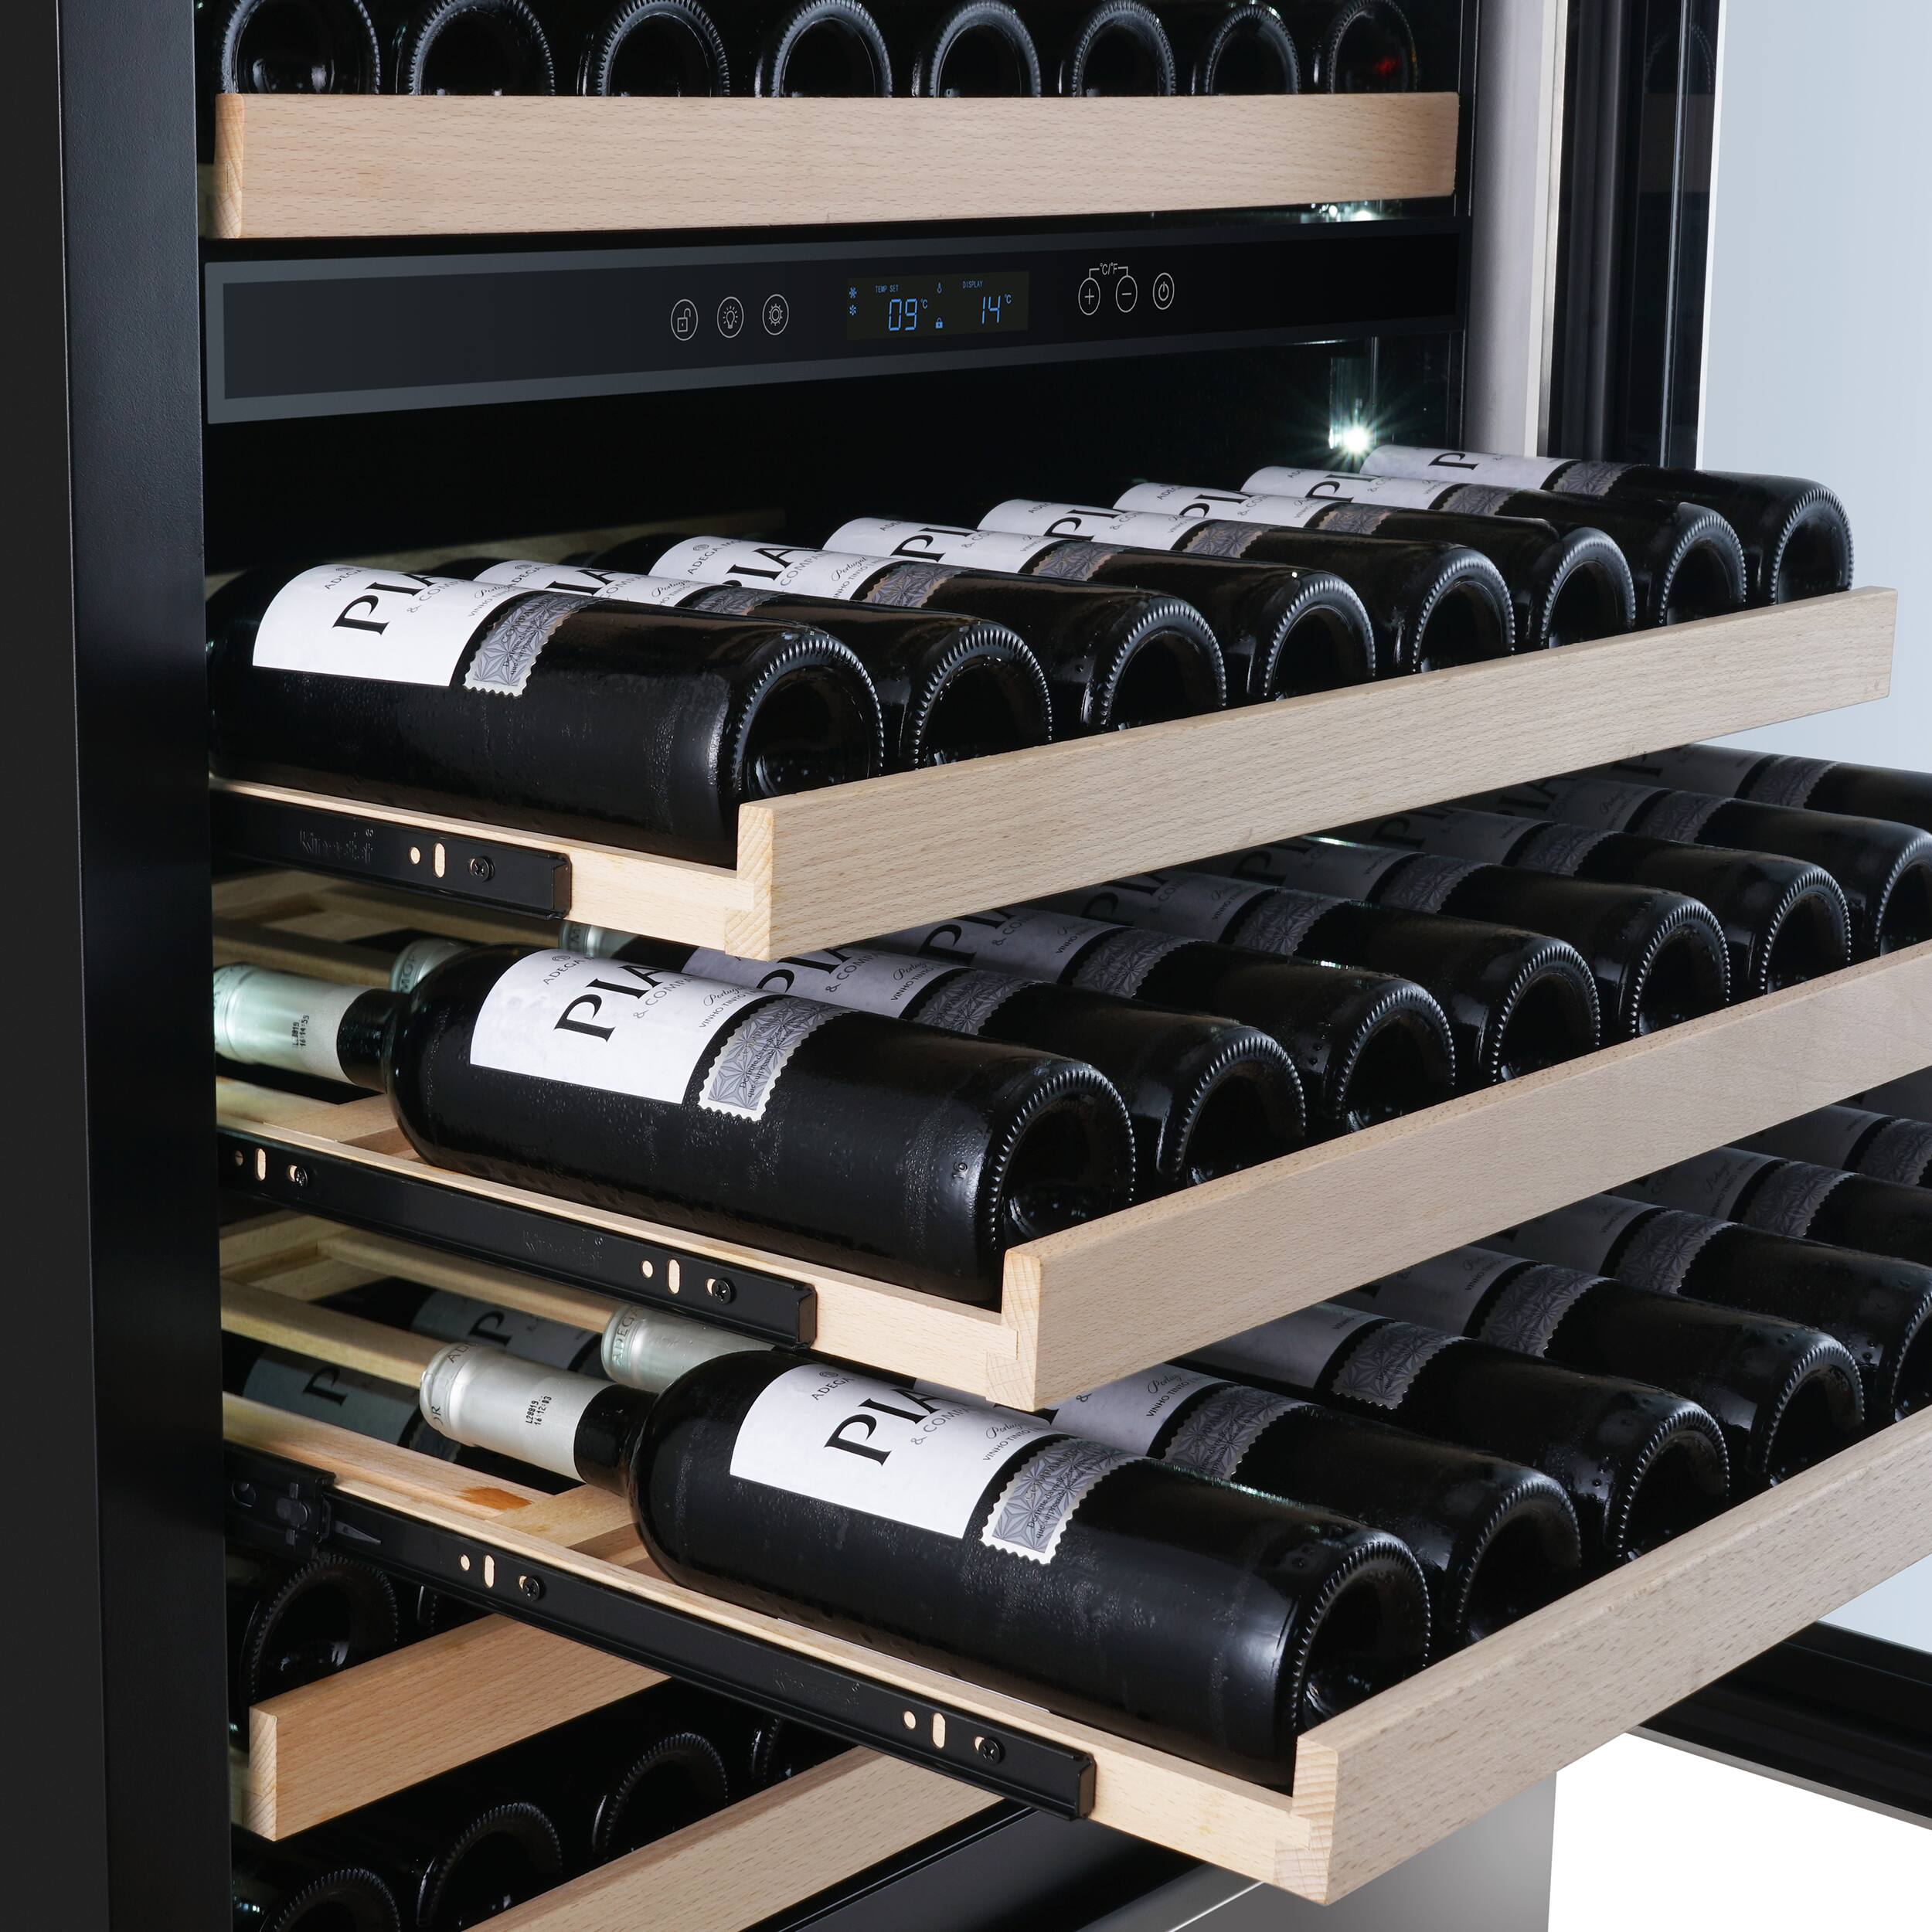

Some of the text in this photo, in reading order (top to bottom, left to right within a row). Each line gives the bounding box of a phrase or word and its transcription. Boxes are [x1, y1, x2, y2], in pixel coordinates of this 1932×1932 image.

[875, 284, 900, 294] TEMP SET
[962, 280, 984, 290] DISPLAY
[888, 298, 918, 332] 09
[981, 294, 1001, 325] 14
[688, 546, 720, 576] ADEGA
[825, 982, 842, 993] &
[889, 980, 914, 1002] VINHO
[632, 1009, 648, 1019] &
[698, 993, 747, 1029] VINHO TINTO
[747, 1083, 756, 1099] que
[811, 1376, 855, 1401] ADEGA
[1075, 1392, 1093, 1403] &
[1145, 1380, 1189, 1417] VINHO TINTO
[525, 1400, 539, 1424] L28819
[910, 1435, 927, 1446] &
[982, 1429, 1031, 1461] VINHO TINTO
[1036, 1523, 1046, 1539] que
